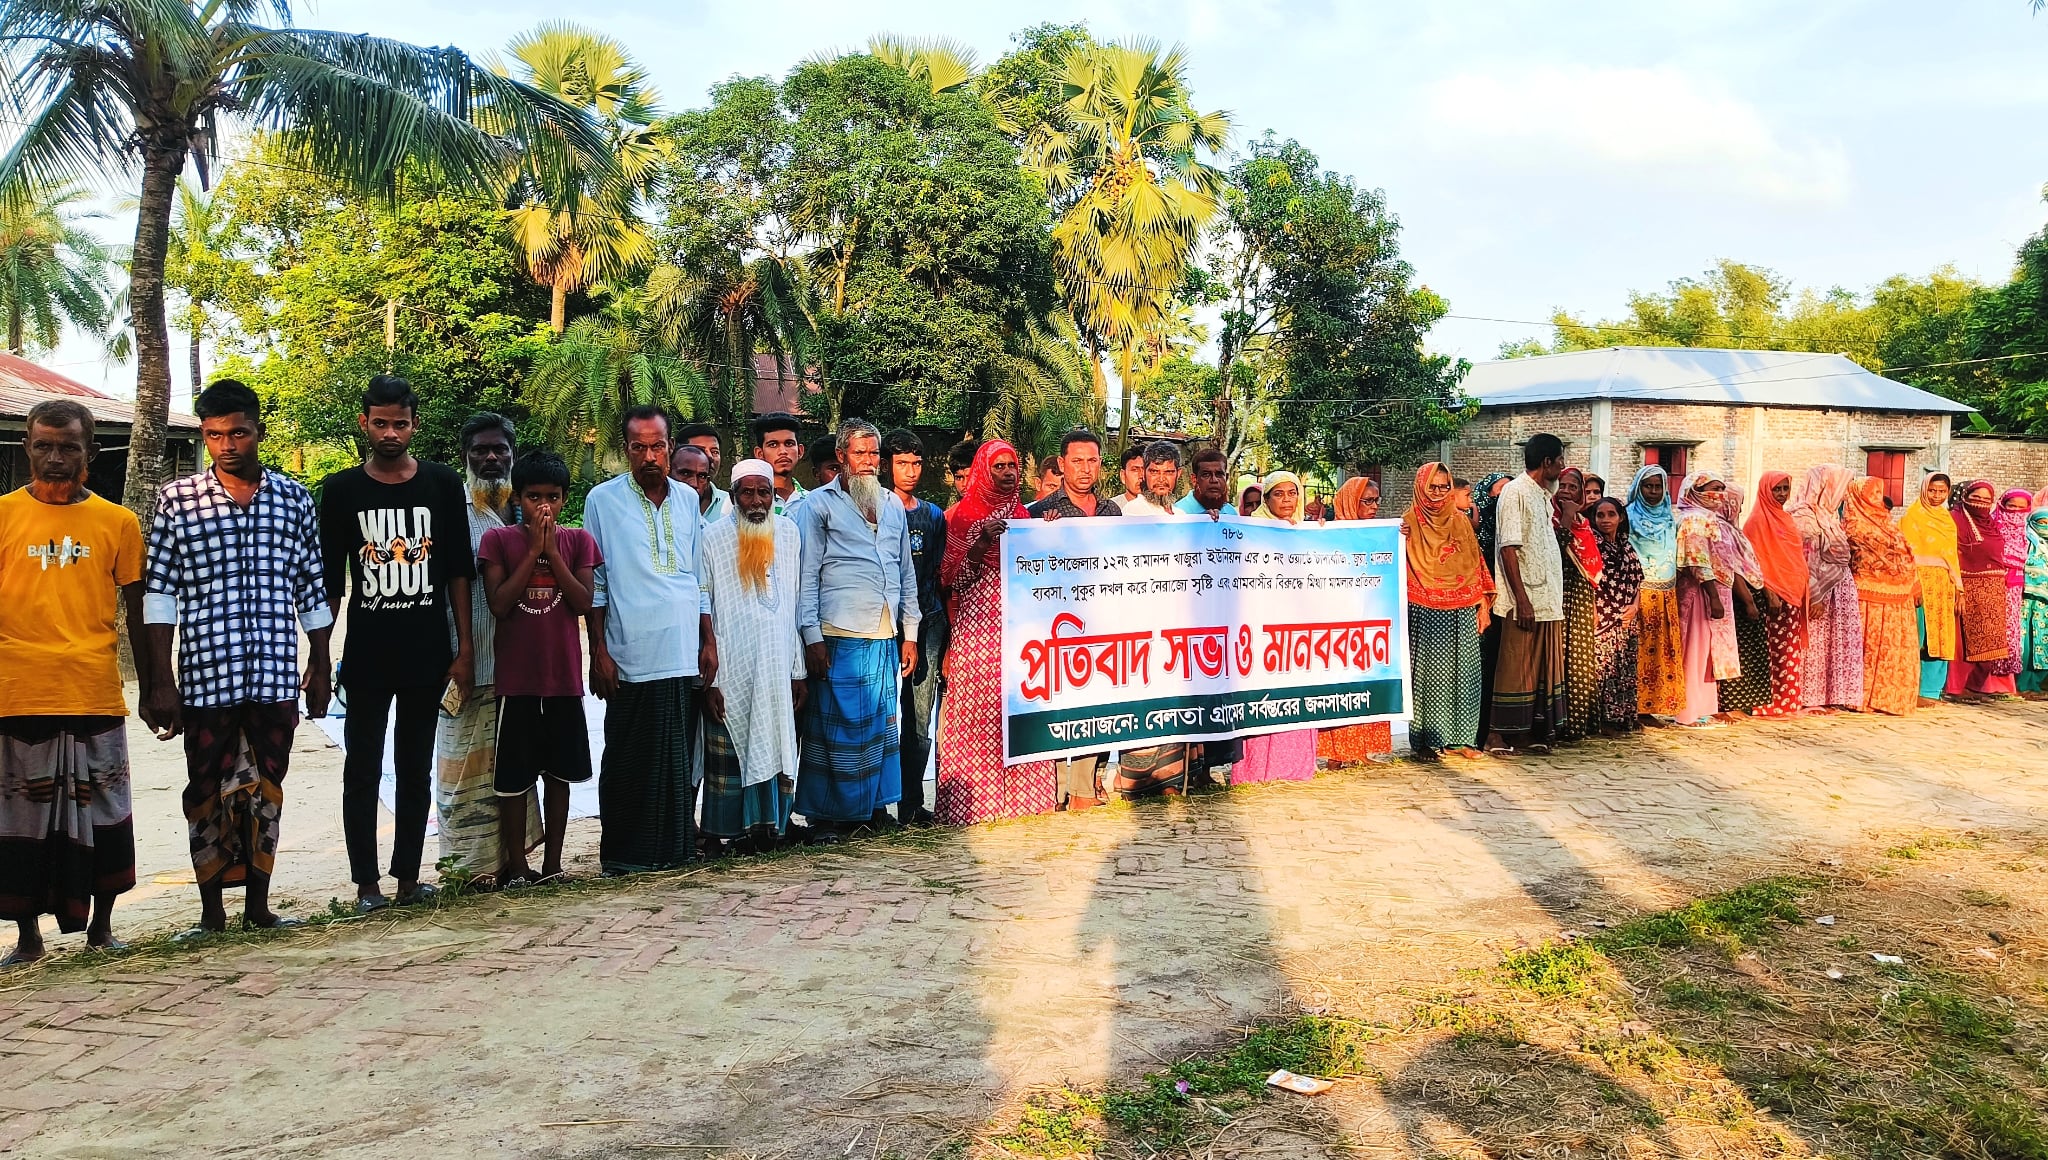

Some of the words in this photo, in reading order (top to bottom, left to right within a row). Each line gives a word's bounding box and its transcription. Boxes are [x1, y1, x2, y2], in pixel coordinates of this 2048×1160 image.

[358, 507, 432, 542] WILD
[1222, 528, 1243, 539] ৭৮৬
[27, 544, 91, 558] BALENCE
[1016, 556, 1045, 576] সিংড়া
[1048, 555, 1099, 571] উপজেলার
[1103, 556, 1129, 569] ১২নং
[1133, 554, 1170, 567] রামানন্দ
[1174, 551, 1203, 567] খাজুরা
[1206, 548, 1242, 564] ইউনিয়ন
[1245, 552, 1260, 564] এর
[1263, 553, 1270, 564] ৩
[1273, 552, 1284, 565] নং
[362, 560, 433, 597] SOUL
[1032, 586, 1067, 602] ব্যবসা,
[1071, 584, 1096, 601] পুকুর
[1099, 582, 1124, 596] দখল
[1127, 582, 1147, 594] করে
[1191, 574, 1214, 596] সৃষ্টি
[1217, 578, 1231, 591] এবং
[1232, 573, 1272, 590] গ্রামবাসীর
[1275, 573, 1304, 590] বিরুদ্ধে
[1307, 574, 1326, 590] মিথ্যা
[361, 596, 382, 611] will
[382, 600, 414, 609] never
[420, 594, 432, 606] die
[1020, 612, 1152, 701] প্রতিবাদ
[1160, 626, 1228, 680] সভা
[1235, 623, 1252, 677] ও
[1263, 619, 1391, 672] মানববন্ধন
[1048, 713, 1139, 742] আয়োজনে:
[1145, 706, 1205, 730] বেলতা
[1209, 703, 1245, 726] গ্রামের
[1248, 693, 1301, 720] সর্বস্তরের
[1304, 690, 1371, 715] জনসাধারণ
